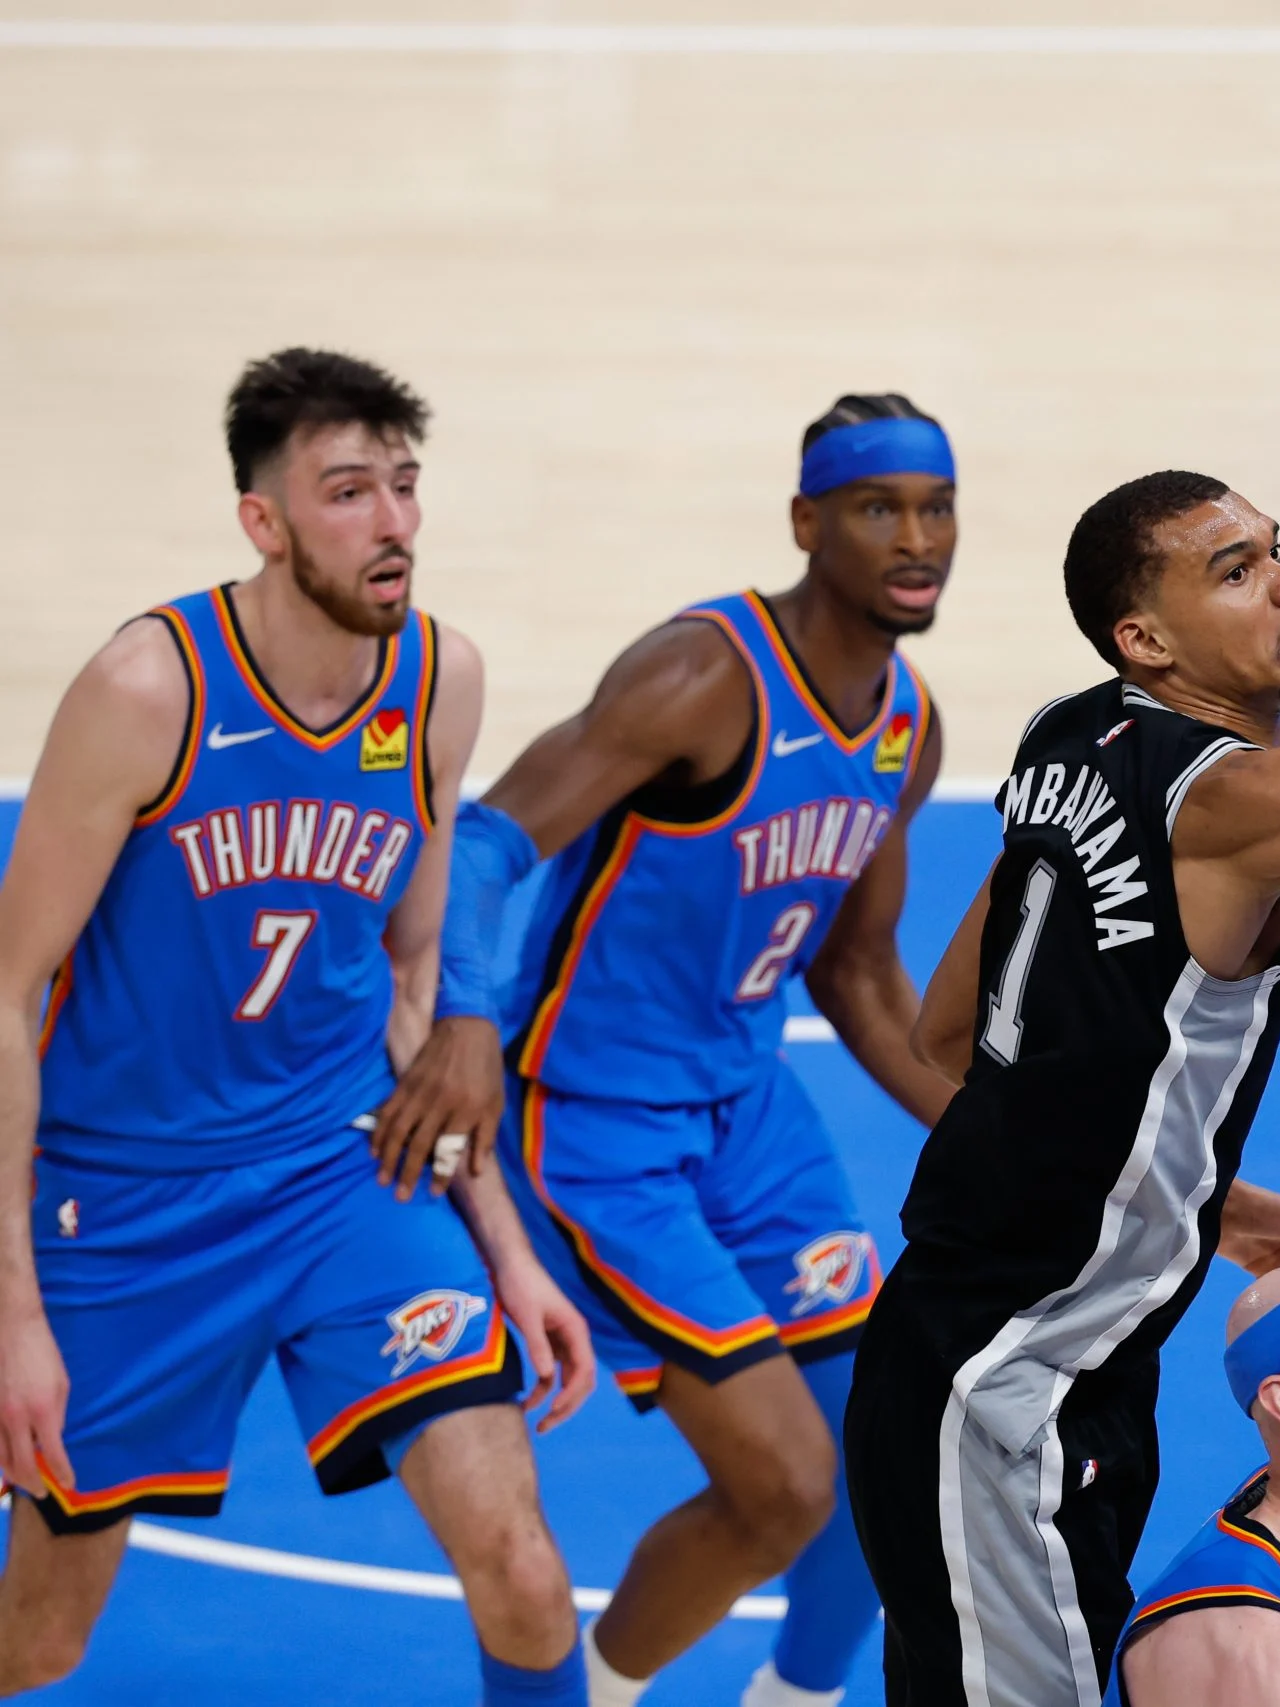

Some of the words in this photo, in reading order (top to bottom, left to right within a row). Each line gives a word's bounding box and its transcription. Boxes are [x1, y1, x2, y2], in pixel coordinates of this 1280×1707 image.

[170, 798, 412, 902] THUNDER
[735, 797, 893, 895] THUNDE
[1003, 763, 1154, 951] MBANYAMA
[233, 909, 318, 1021] 7
[737, 903, 816, 1001] 2
[980, 857, 1057, 1067] 1
